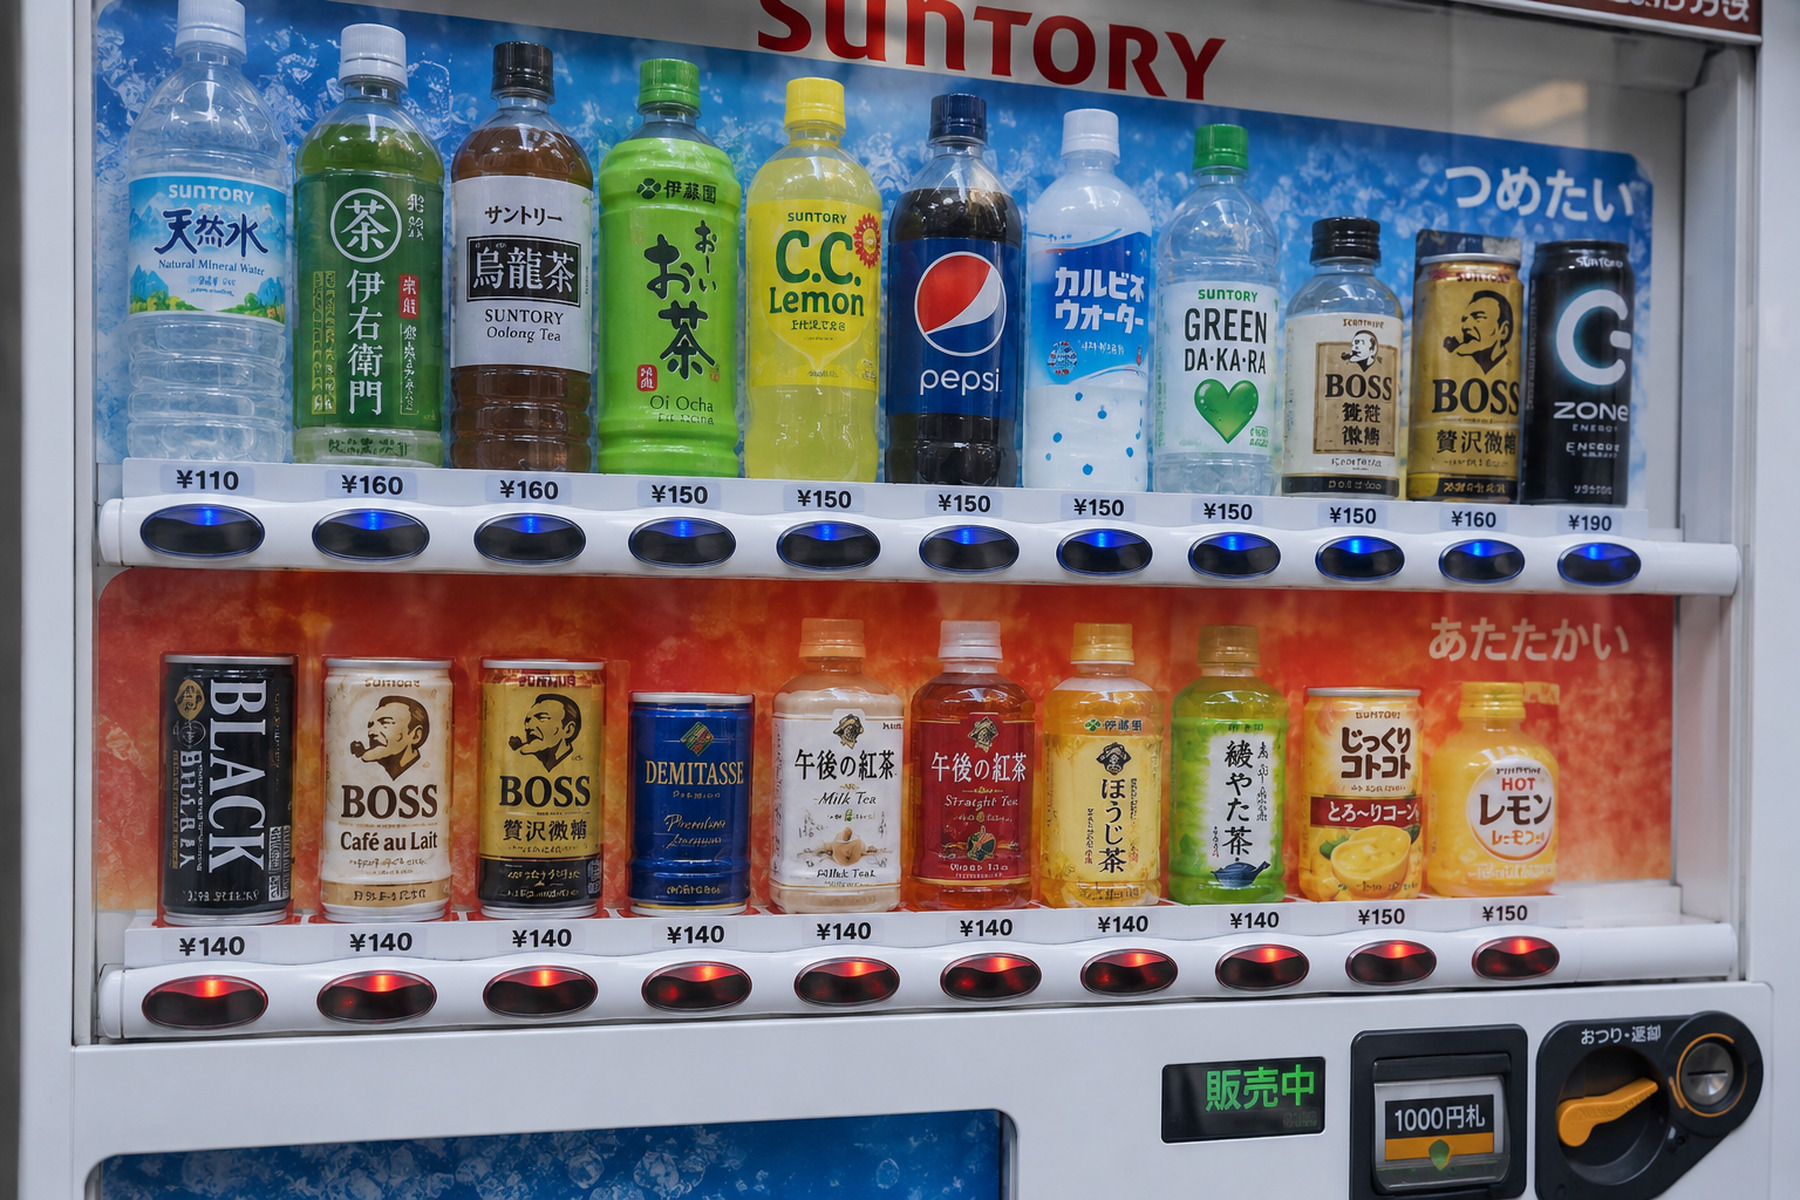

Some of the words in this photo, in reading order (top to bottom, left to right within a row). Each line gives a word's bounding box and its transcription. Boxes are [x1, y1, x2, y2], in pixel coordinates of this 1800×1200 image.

[168, 184, 255, 205] SUNTORY
[1445, 166, 1634, 222] つめたい
[340, 199, 391, 252] 茶
[484, 205, 563, 226] サントリー
[788, 211, 847, 225] SUNTORY
[154, 208, 268, 258] 天然水
[158, 258, 195, 270] Natural
[775, 229, 862, 287] C.C.
[769, 286, 865, 317] Lemon
[1198, 288, 1259, 303] SUNTORY
[484, 308, 565, 325] SUNTORY
[643, 232, 716, 381] お茶
[486, 326, 536, 343] Oolong
[539, 327, 561, 342] Tea
[1184, 307, 1267, 345] GREEN
[346, 268, 386, 415] 伊右衛門
[919, 367, 1000, 396] pepsi
[1324, 373, 1392, 401] BOSS
[650, 394, 670, 410] Oi
[676, 395, 714, 413] Ocha
[1431, 377, 1519, 416] BOSS
[176, 469, 239, 491] ¥110
[341, 474, 404, 496] ¥160
[499, 479, 559, 500] ¥160
[651, 484, 708, 505] ¥150
[797, 489, 852, 509] ¥150
[938, 493, 991, 513] ¥150
[1073, 498, 1125, 517] ¥150
[1203, 502, 1253, 521] ¥150
[1329, 506, 1377, 525] ¥150
[1451, 510, 1497, 528] ¥160
[1568, 514, 1613, 532] ¥190
[1428, 616, 1630, 662] あたたかい
[1341, 726, 1412, 754] じっくり
[644, 759, 744, 786] DEMITASSE
[794, 748, 896, 781] 午後の紅茶
[930, 751, 1027, 783] 午後の紅茶
[1341, 753, 1412, 781] コトコト
[208, 678, 267, 873] BLACK
[1501, 777, 1536, 791] HOT
[340, 783, 438, 819] BOSS
[499, 775, 591, 808] BOSS
[818, 791, 852, 805] Milk
[1479, 793, 1552, 826] レモン
[1097, 778, 1127, 874] ほうじ茶
[340, 831, 380, 852] Café
[383, 837, 407, 852] au
[410, 830, 438, 851] Lait
[1230, 911, 1280, 929] ¥140
[1358, 908, 1405, 925] ¥150
[1482, 904, 1528, 922] ¥150
[667, 925, 725, 944] ¥140
[816, 921, 872, 941] ¥140
[959, 918, 1013, 937] ¥140
[1097, 915, 1149, 933] ¥140
[179, 936, 245, 957] ¥140
[349, 932, 413, 952] ¥140
[512, 928, 572, 948] ¥140
[1205, 1063, 1315, 1112] 販売中
[1394, 1103, 1486, 1132] 1000円札
